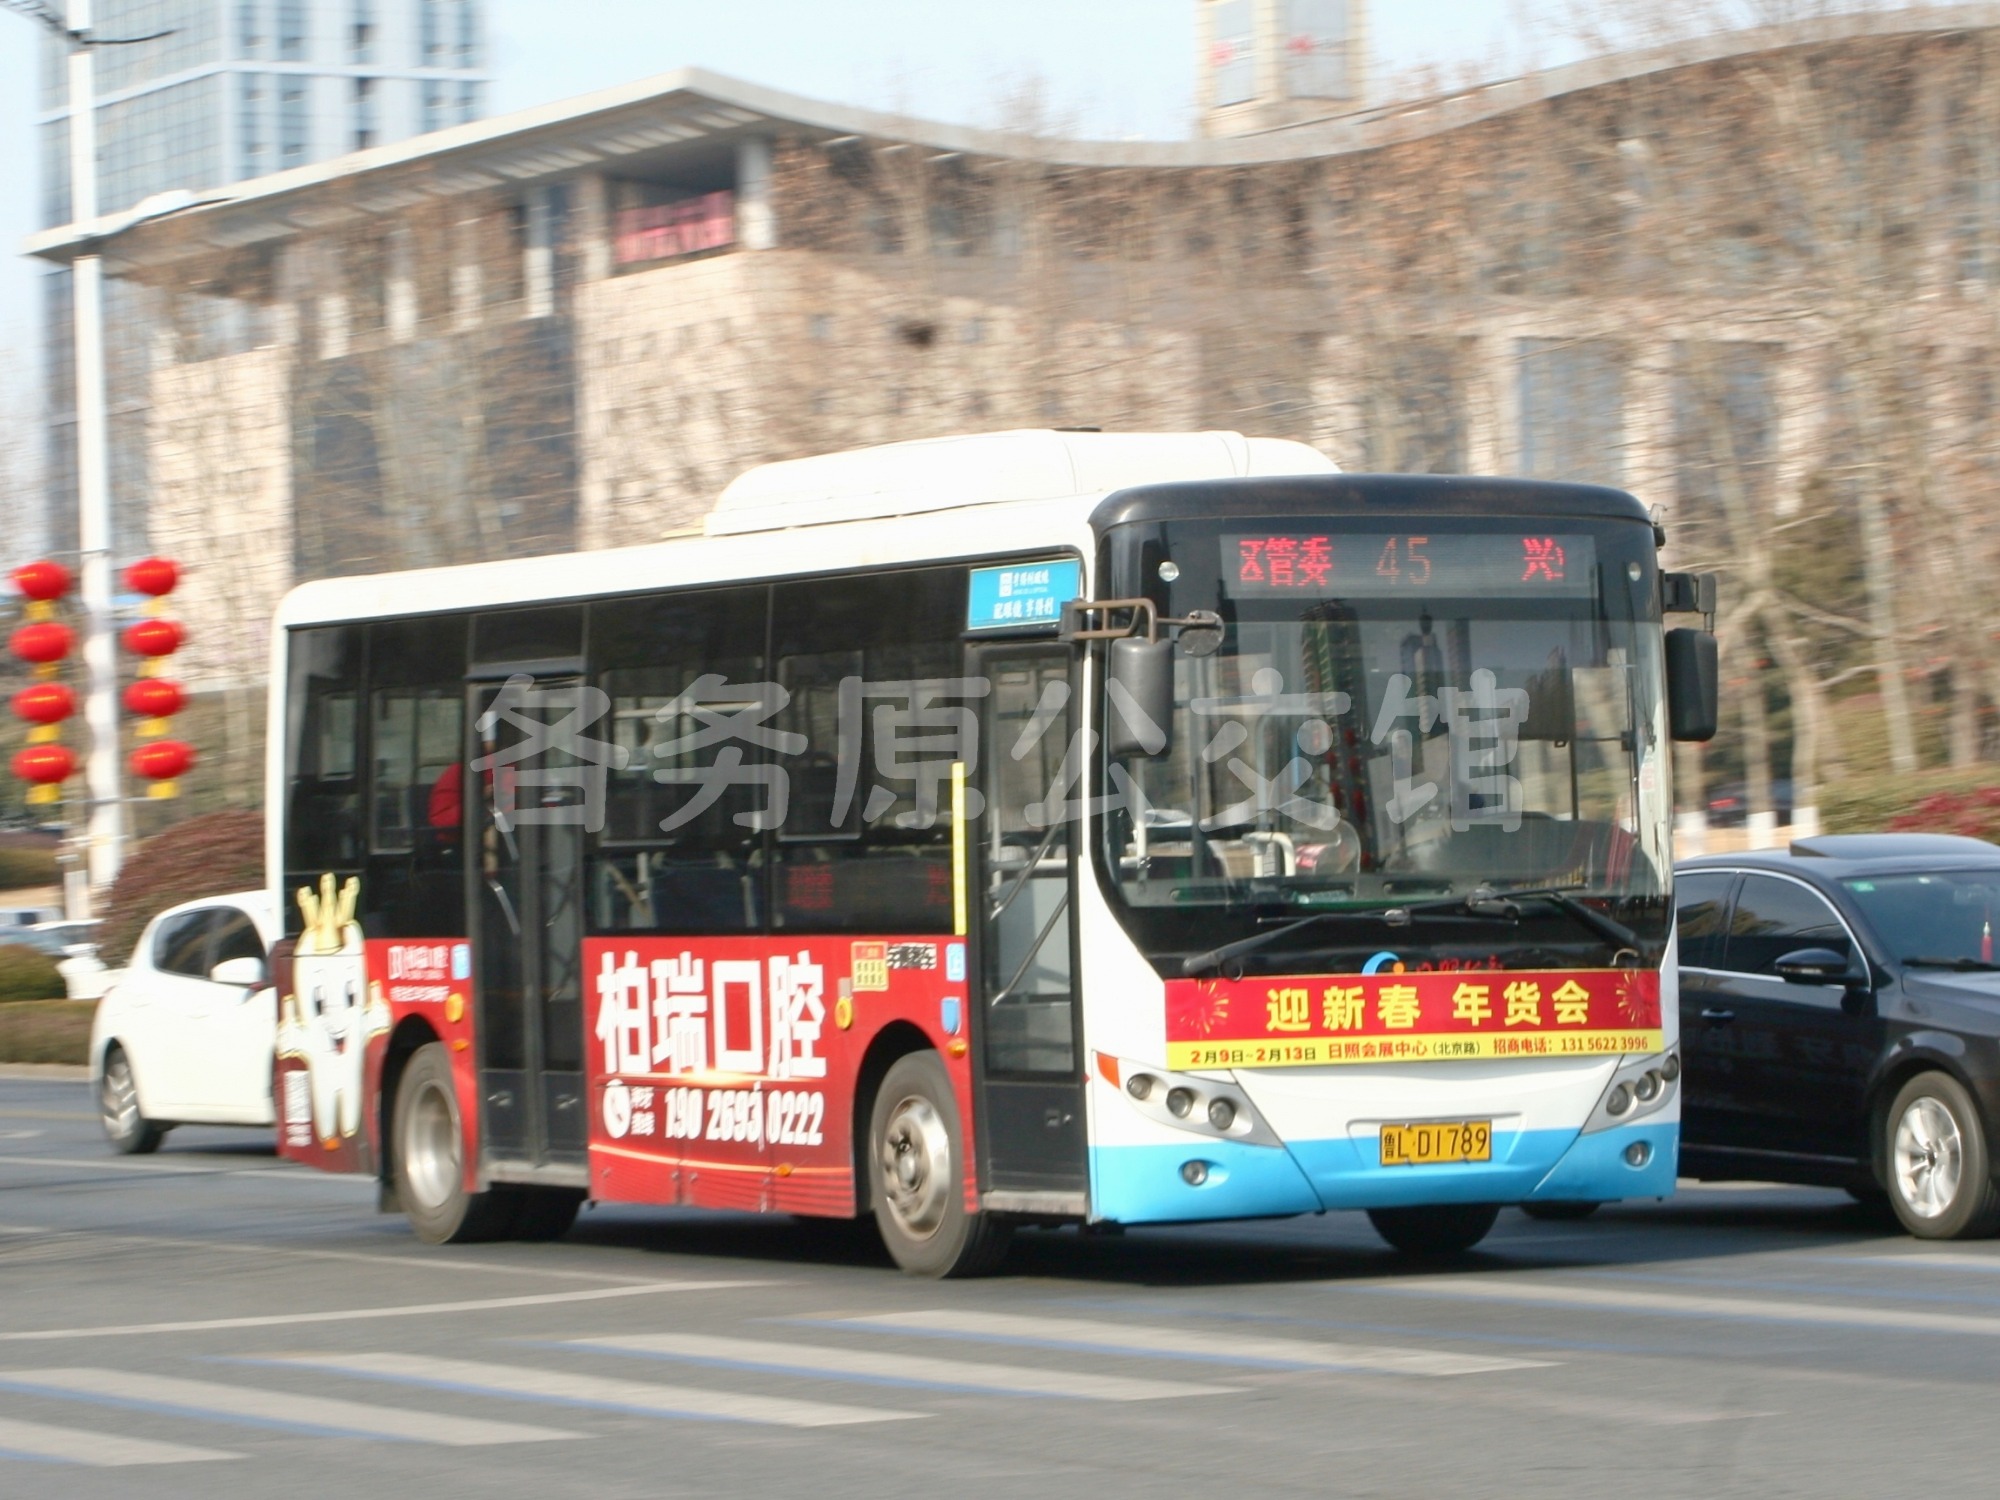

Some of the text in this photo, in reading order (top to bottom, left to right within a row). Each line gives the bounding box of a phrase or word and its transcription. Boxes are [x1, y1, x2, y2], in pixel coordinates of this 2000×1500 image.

[1376, 537, 1431, 585] 45
[596, 950, 827, 1078] 柏瑞口腔
[1266, 980, 1590, 1031] 迎新春 年货会
[665, 1087, 703, 1139] 190
[767, 1090, 824, 1145] 0222
